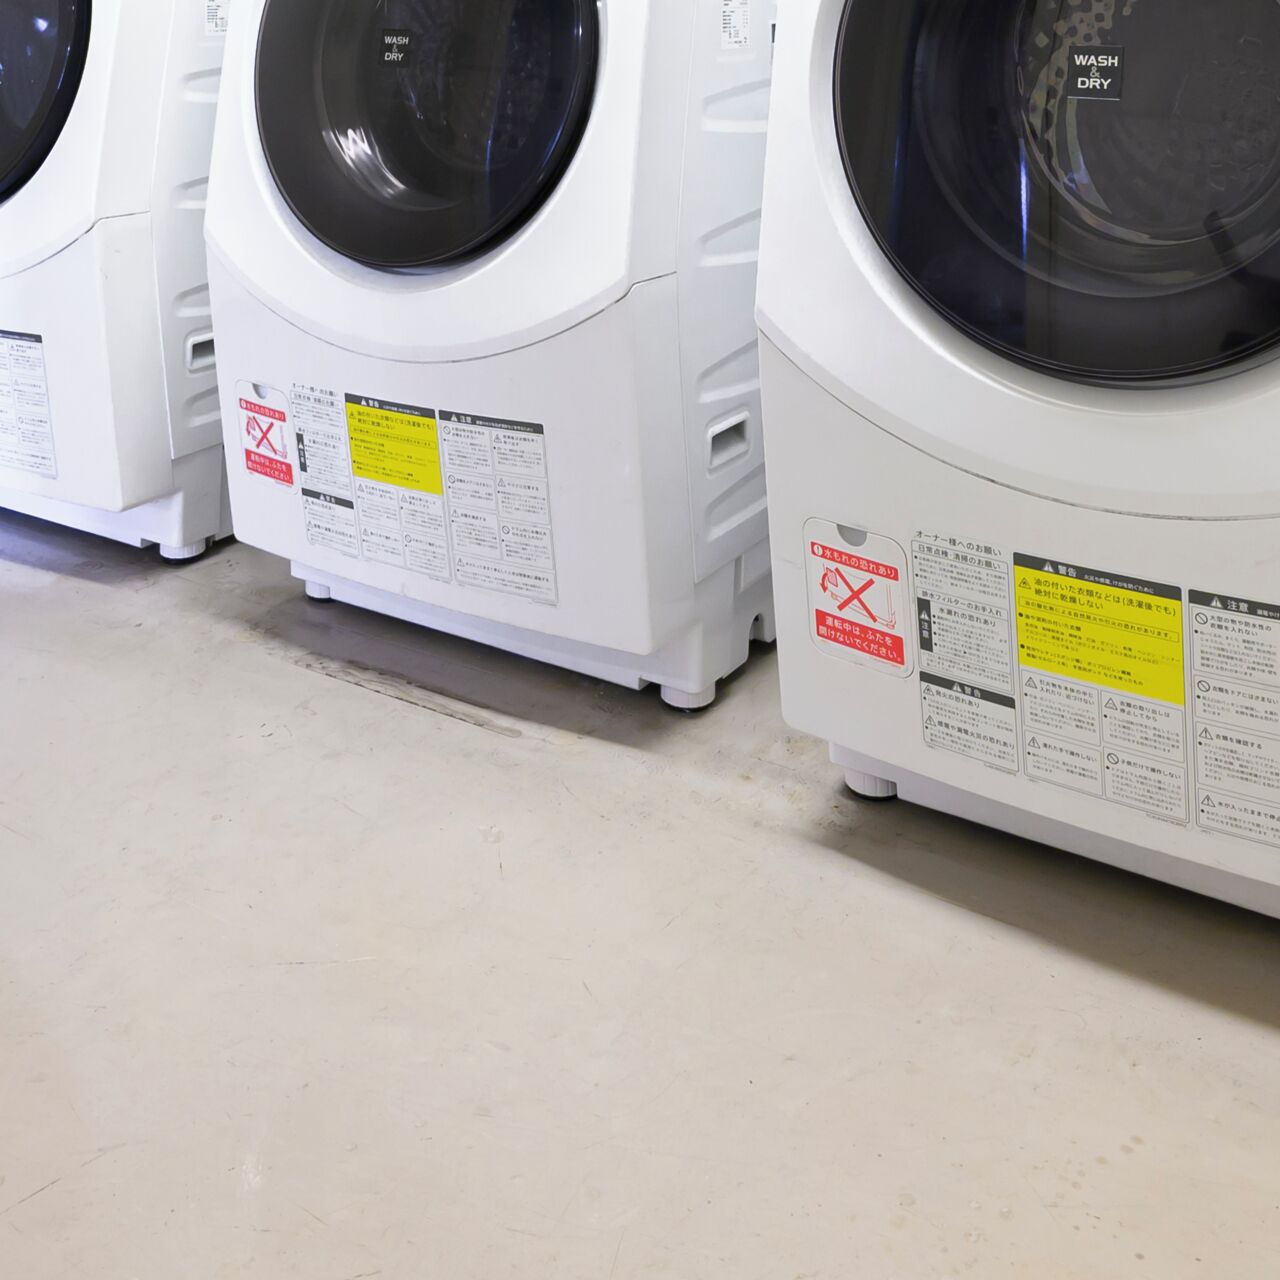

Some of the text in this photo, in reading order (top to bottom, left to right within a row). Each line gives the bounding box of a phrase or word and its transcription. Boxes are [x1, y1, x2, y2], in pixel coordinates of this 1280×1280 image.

[384, 35, 409, 45] WASH
[384, 52, 404, 62] DRY
[1074, 54, 1119, 67] WASH
[1089, 66, 1100, 78] &
[1077, 77, 1112, 90] DRY
[915, 530, 1002, 557] オーナー様へのお願い
[824, 547, 895, 578] 水もれの恐れあり
[1057, 565, 1078, 578] 警告
[1034, 577, 1177, 617] 油の付いた衣類などは(洗濯後でも)
[1034, 589, 1104, 610] 絶対に乾燥しない
[1226, 599, 1250, 614] 注意
[939, 607, 996, 628] 水漏れの恐れあり
[825, 615, 893, 647] 運転中は、ふたを
[1210, 623, 1258, 636] 衣類を入れない
[818, 624, 901, 662] 開けないでください。
[1119, 700, 1171, 719] 衣類の取り出しは
[1119, 708, 1159, 723] 停止してから
